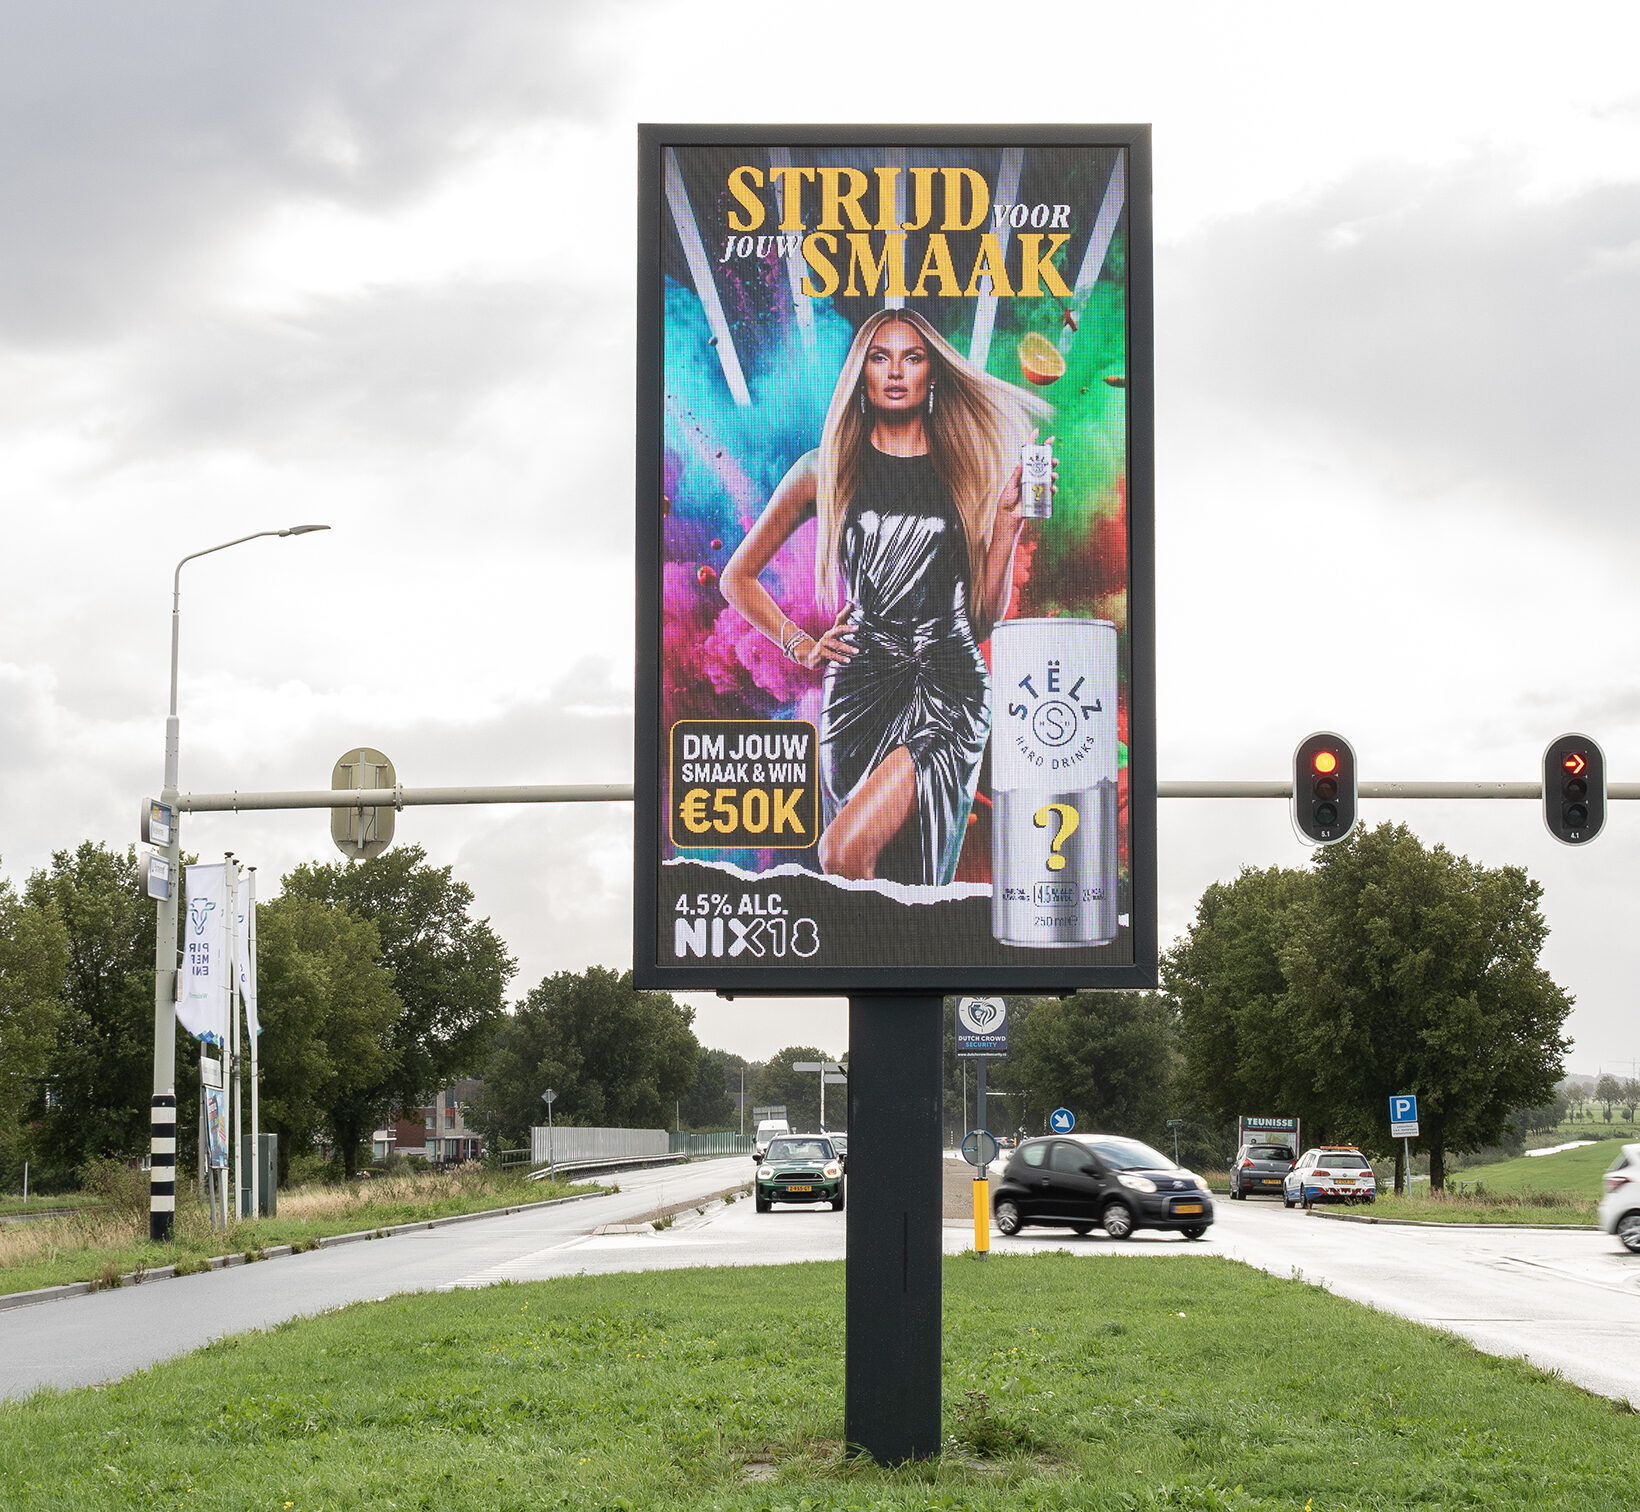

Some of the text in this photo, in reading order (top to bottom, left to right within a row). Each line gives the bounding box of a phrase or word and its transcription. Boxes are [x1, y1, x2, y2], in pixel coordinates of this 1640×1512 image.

[727, 165, 1071, 231] STRIJD VOOR
[719, 232, 1074, 297] JOUW SMAAK
[683, 734, 809, 760] DM JOUW
[1015, 735, 1095, 770] HARD DRINKS
[681, 763, 806, 783] SMAAK & WIN
[679, 788, 806, 834] €50K
[675, 893, 789, 916] 4.5% ALC.
[1247, 1118, 1293, 1127] TEUNISSE
[1396, 1099, 1411, 1120] P
